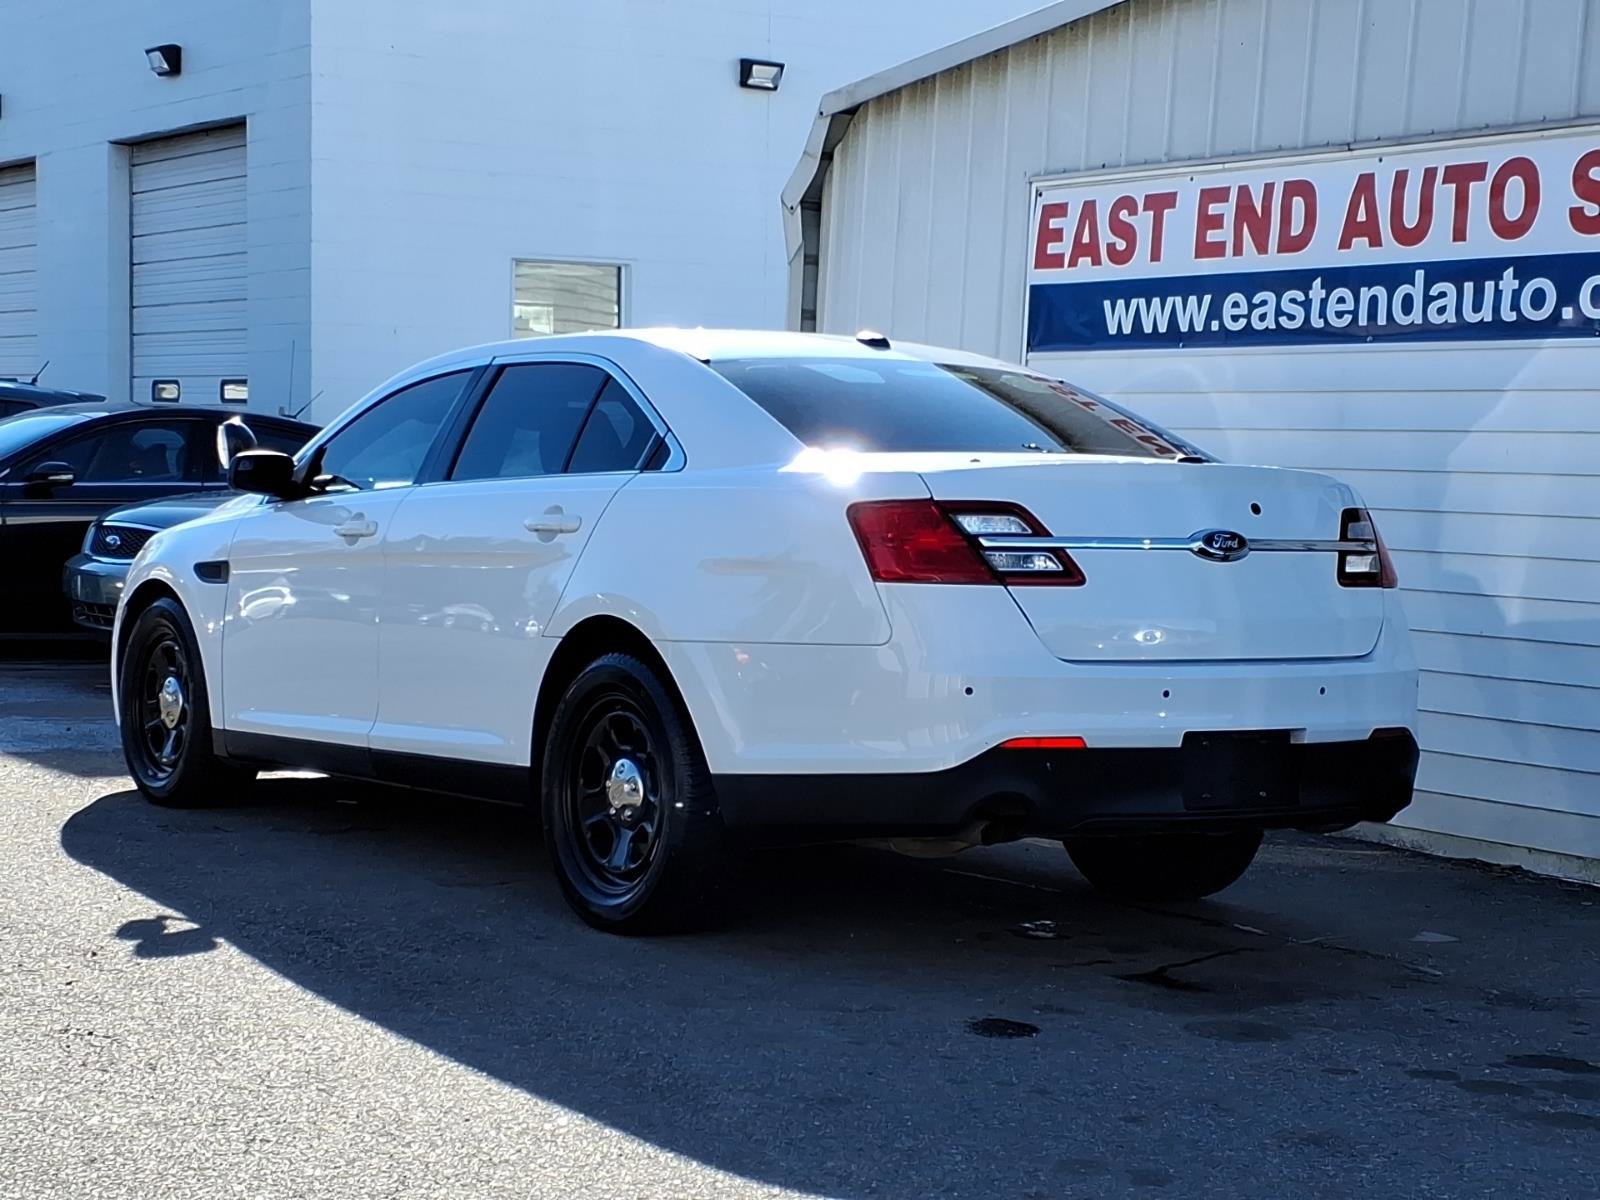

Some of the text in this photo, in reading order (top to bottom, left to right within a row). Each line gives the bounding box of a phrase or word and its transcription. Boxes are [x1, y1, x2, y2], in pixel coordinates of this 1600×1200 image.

[1033, 190, 1179, 270] EAST
[1194, 179, 1318, 260] END
[1338, 156, 1542, 251] AUTO
[1212, 533, 1239, 548] Ford
